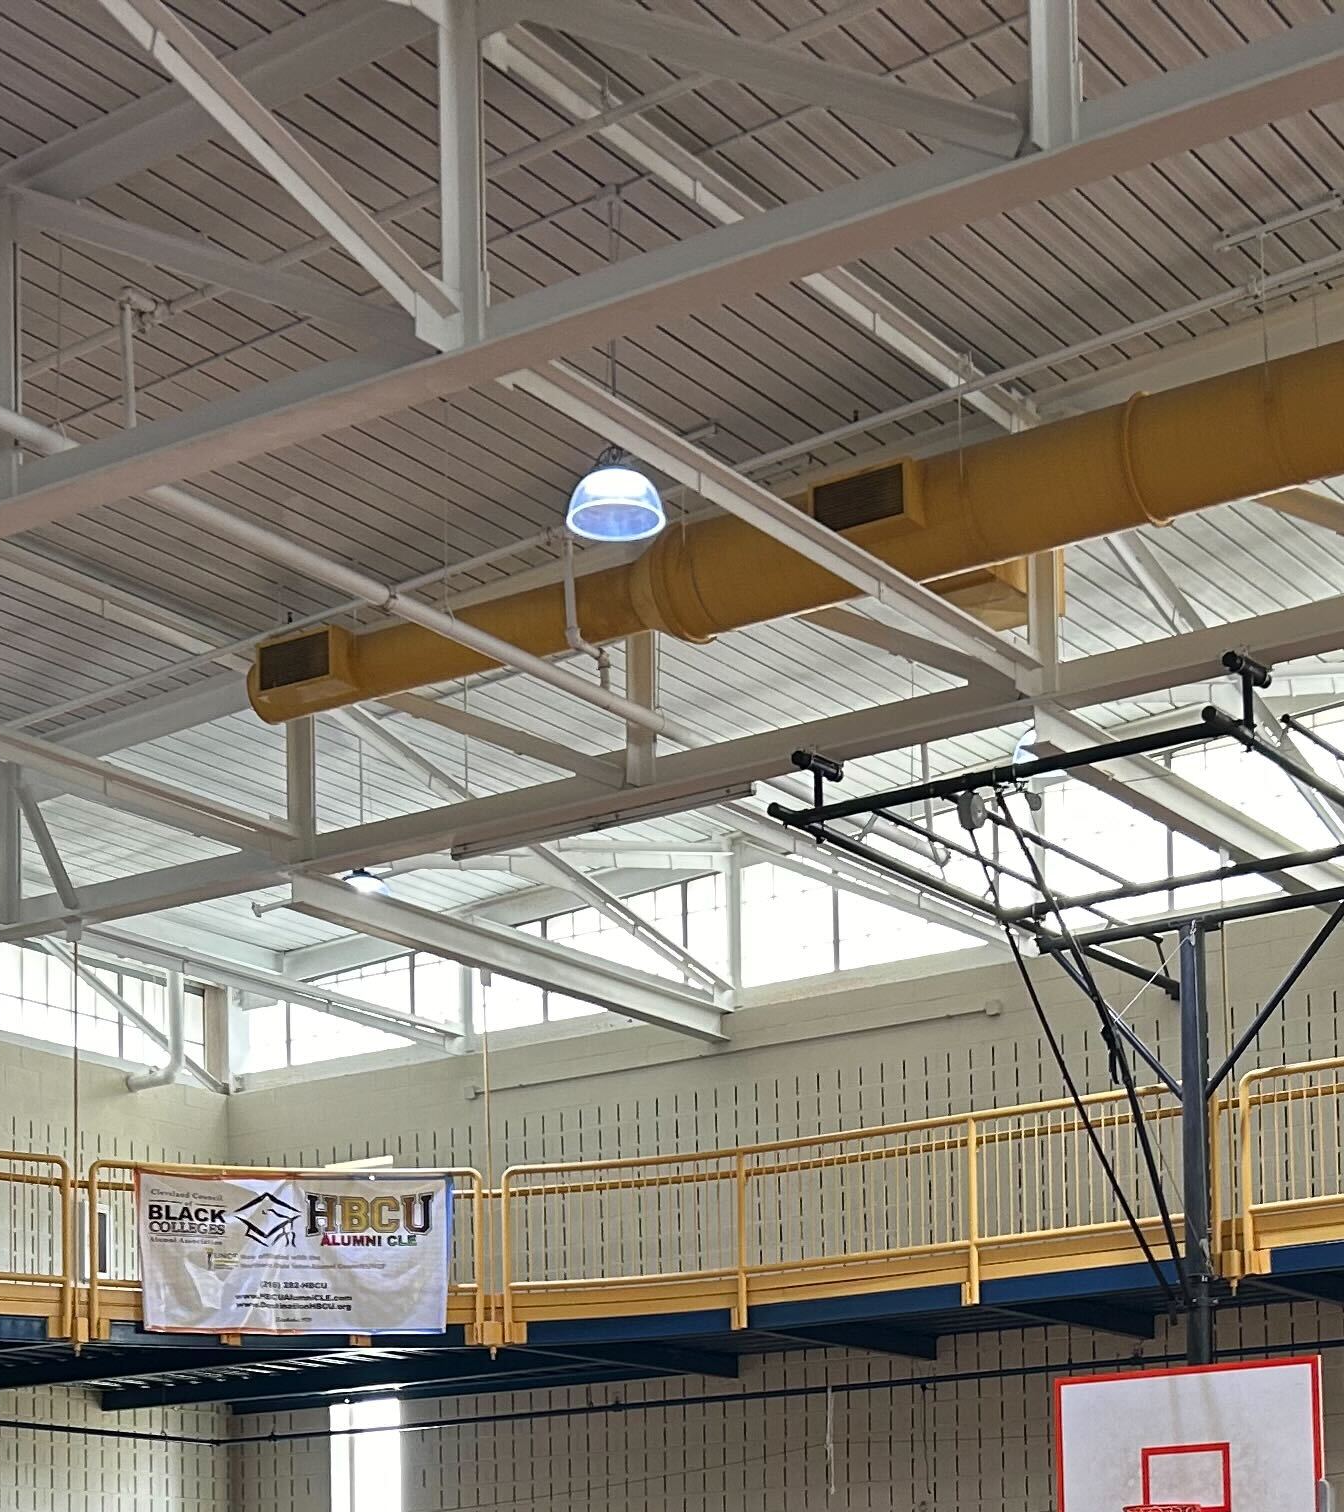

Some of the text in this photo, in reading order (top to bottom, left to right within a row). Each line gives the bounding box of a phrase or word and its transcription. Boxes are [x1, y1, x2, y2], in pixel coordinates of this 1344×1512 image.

[149, 1204, 226, 1223] BLACK
[305, 1191, 434, 1237] HBCU
[149, 1221, 226, 1235] COLLEGES
[320, 1233, 417, 1246] ALUMNI CLE
